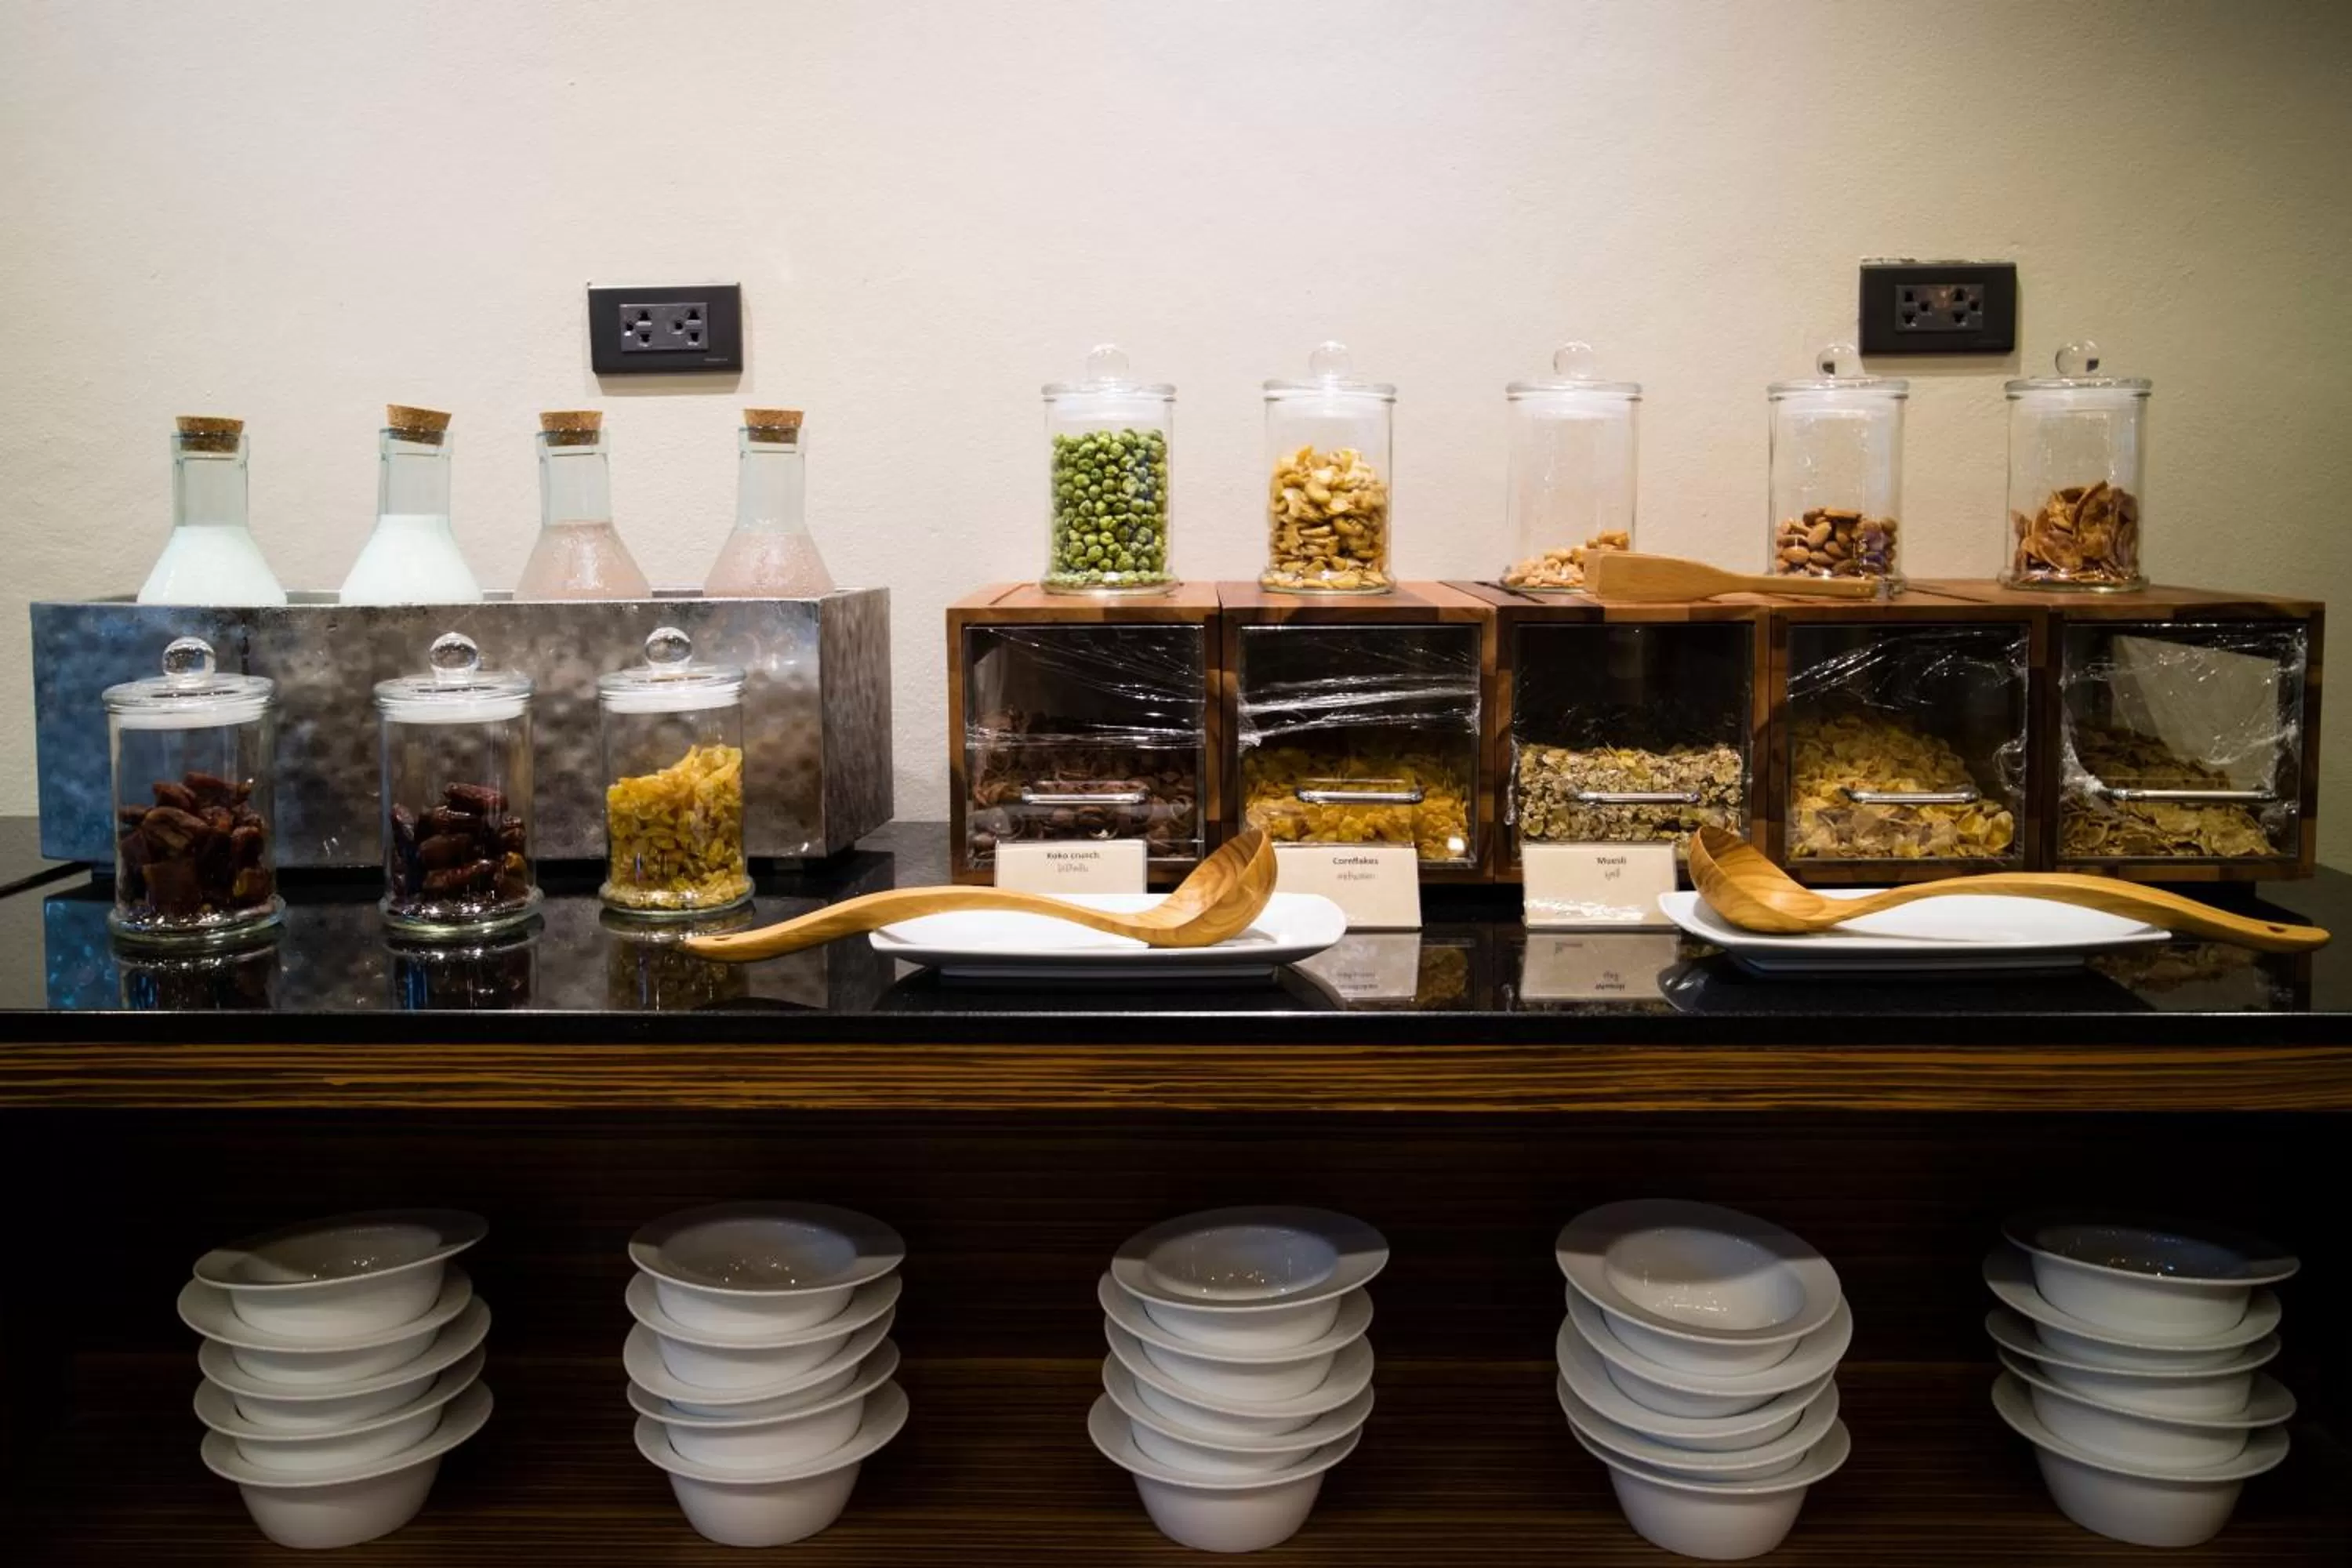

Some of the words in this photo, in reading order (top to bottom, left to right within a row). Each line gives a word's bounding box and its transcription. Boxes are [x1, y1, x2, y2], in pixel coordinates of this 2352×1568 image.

[1071, 851, 1100, 860] crunch
[1333, 856, 1379, 866] Cornflakes
[1597, 856, 1627, 865] Muesli
